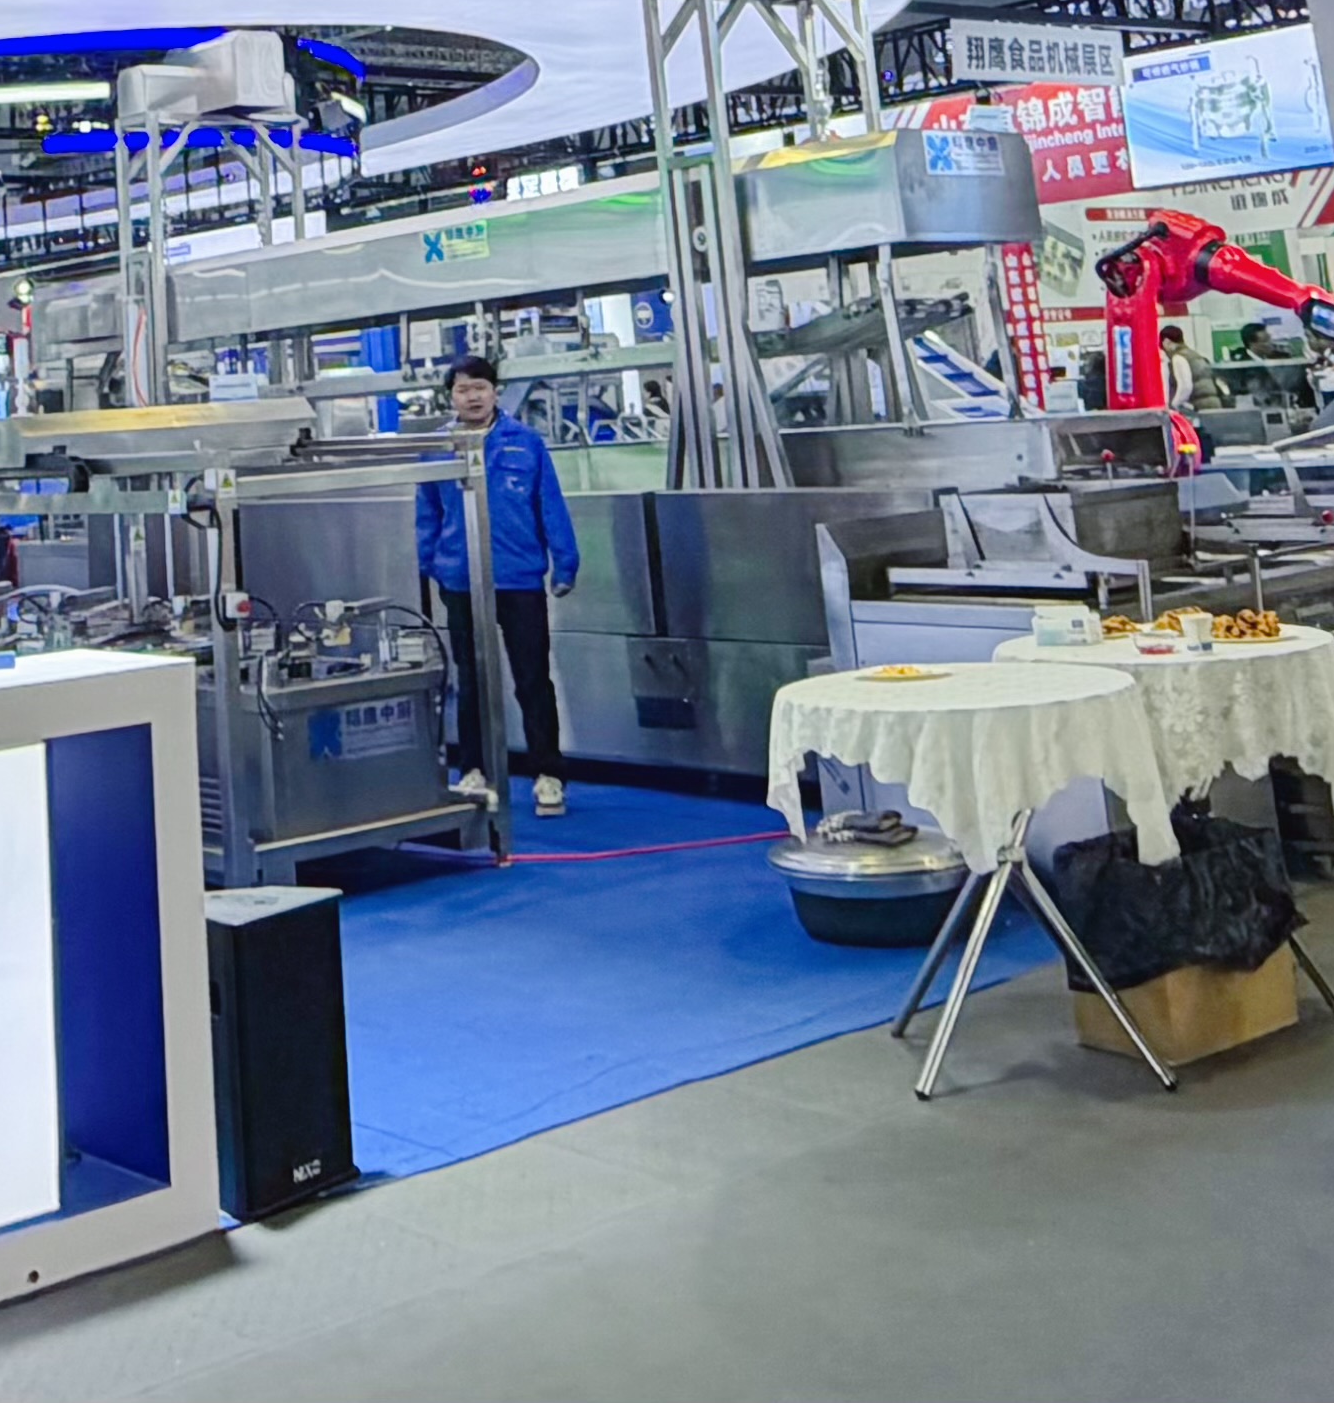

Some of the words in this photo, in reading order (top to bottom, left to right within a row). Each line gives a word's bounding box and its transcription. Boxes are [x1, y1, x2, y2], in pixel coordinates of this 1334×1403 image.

[966, 35, 1116, 77] 翔鹰食品机械展区
